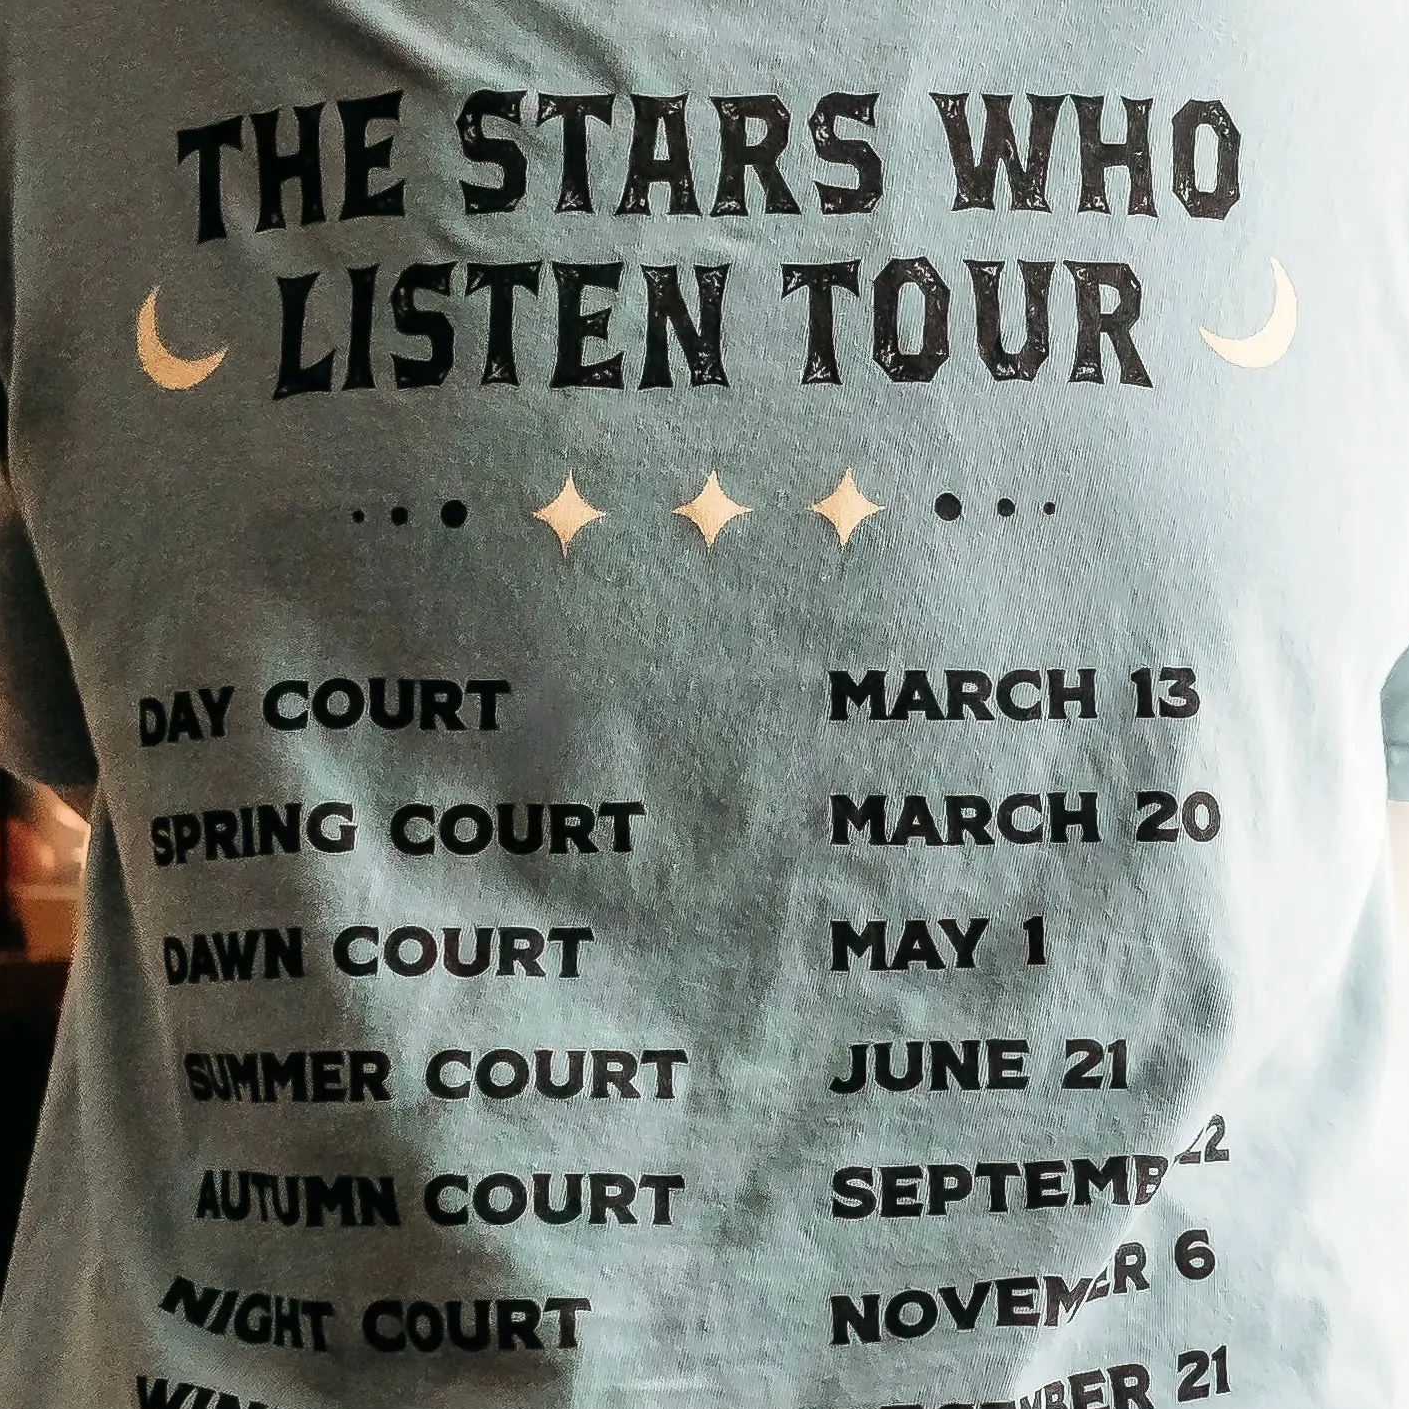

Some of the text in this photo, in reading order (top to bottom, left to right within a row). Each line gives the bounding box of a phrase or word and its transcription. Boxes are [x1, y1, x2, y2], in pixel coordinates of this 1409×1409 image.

[176, 89, 1239, 245] THE STARS WHO
[272, 257, 1151, 401] LISTEN TOUR
[140, 677, 511, 747] DAY COURT
[829, 668, 1199, 721] MARCH 13
[152, 803, 645, 866] SPRING COURT
[831, 791, 1220, 845] MARCH 20
[164, 927, 593, 984] DAWN COURT
[831, 916, 1046, 971] MAY 1
[184, 1050, 687, 1103] SUMMER COURT
[830, 1040, 1127, 1094] JUNE 21
[197, 1171, 684, 1228] AUTUMN COURT
[831, 1155, 1168, 1219] SEPTEMB
[1175, 1230, 1215, 1279] 6
[159, 1276, 591, 1353] NIGHT COURT
[1178, 1346, 1229, 1401] 21
